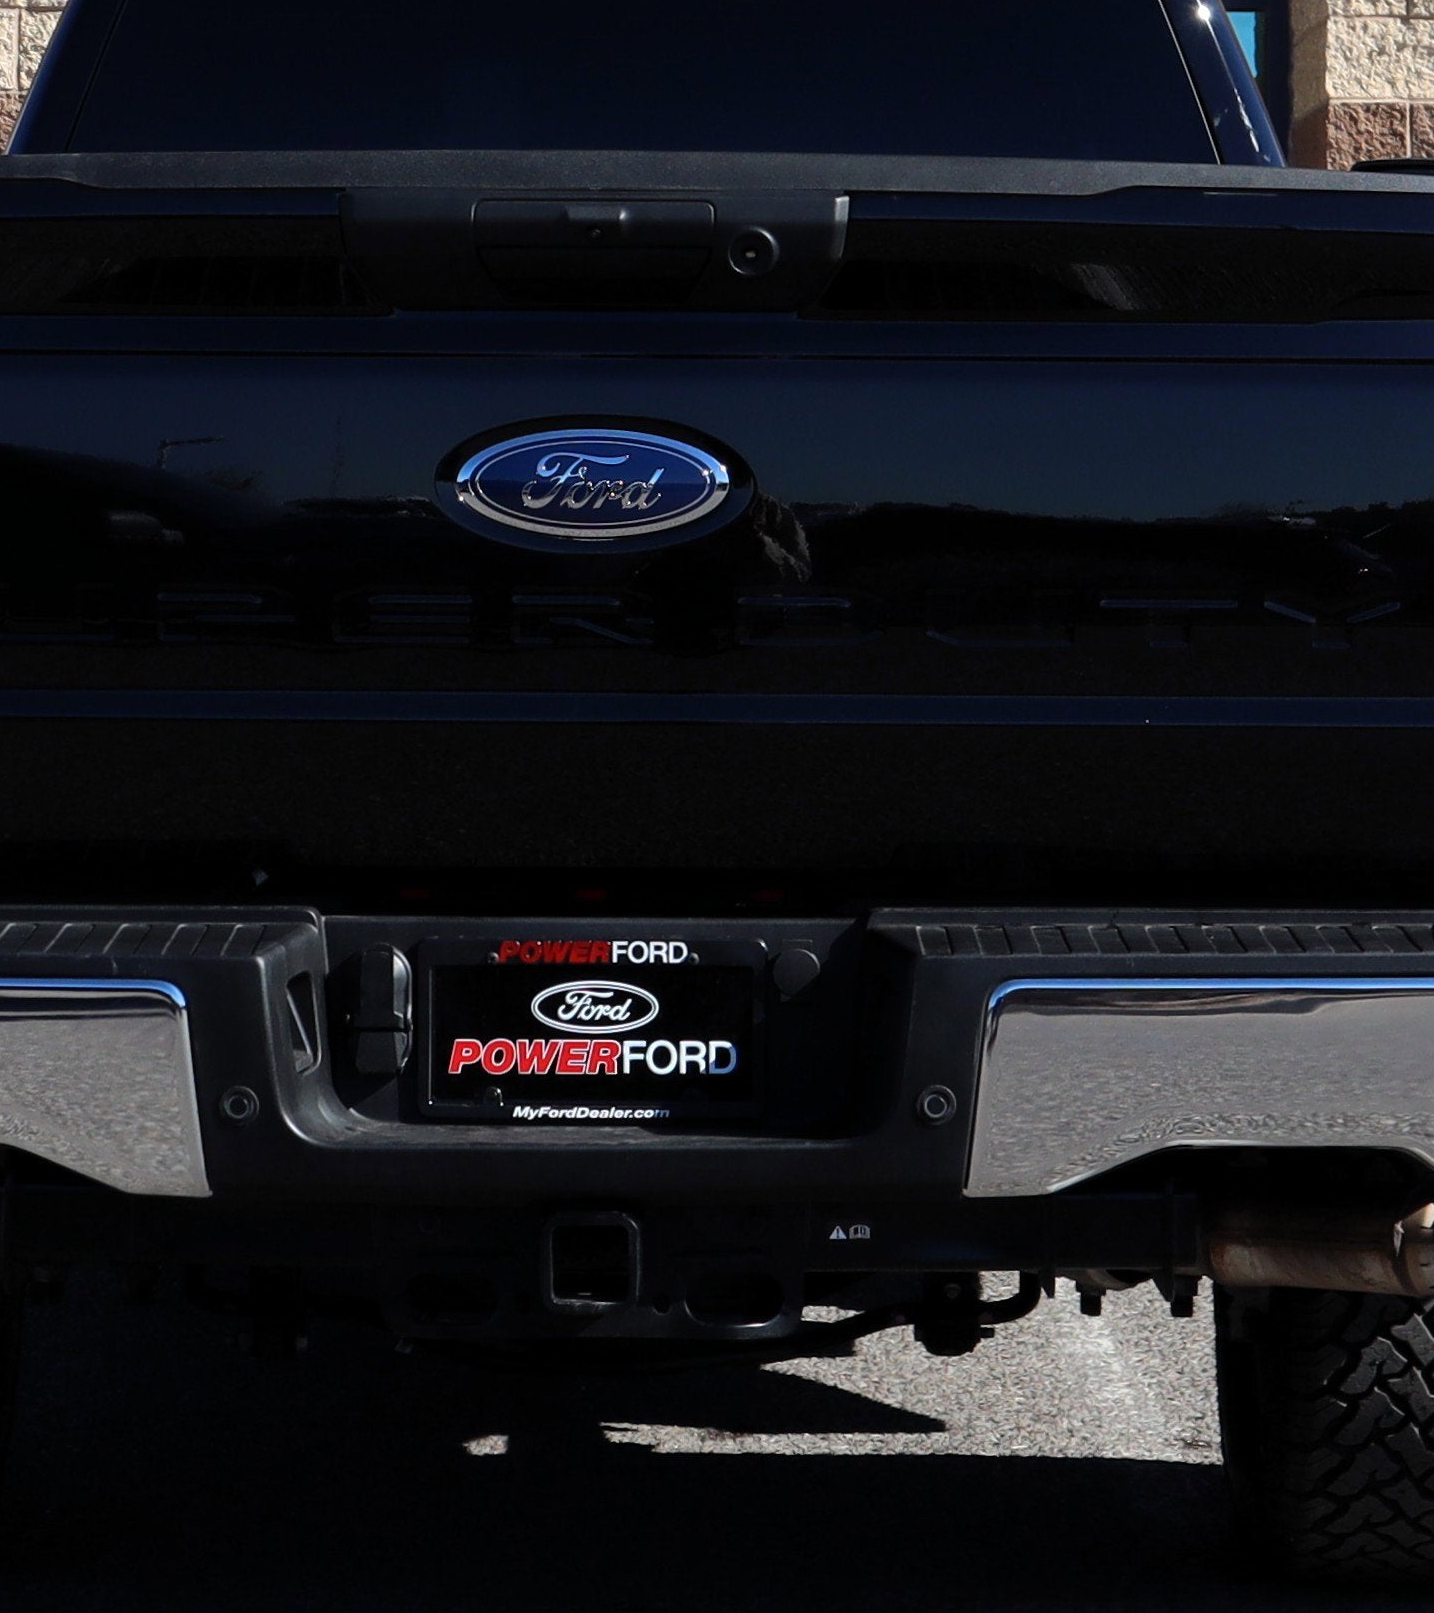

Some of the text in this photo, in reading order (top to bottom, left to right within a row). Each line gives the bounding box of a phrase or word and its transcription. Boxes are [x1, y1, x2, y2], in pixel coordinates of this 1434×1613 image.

[521, 451, 665, 510] Ford
[557, 990, 632, 1023] Ford
[512, 1105, 670, 1121] MyFordDealer.com
